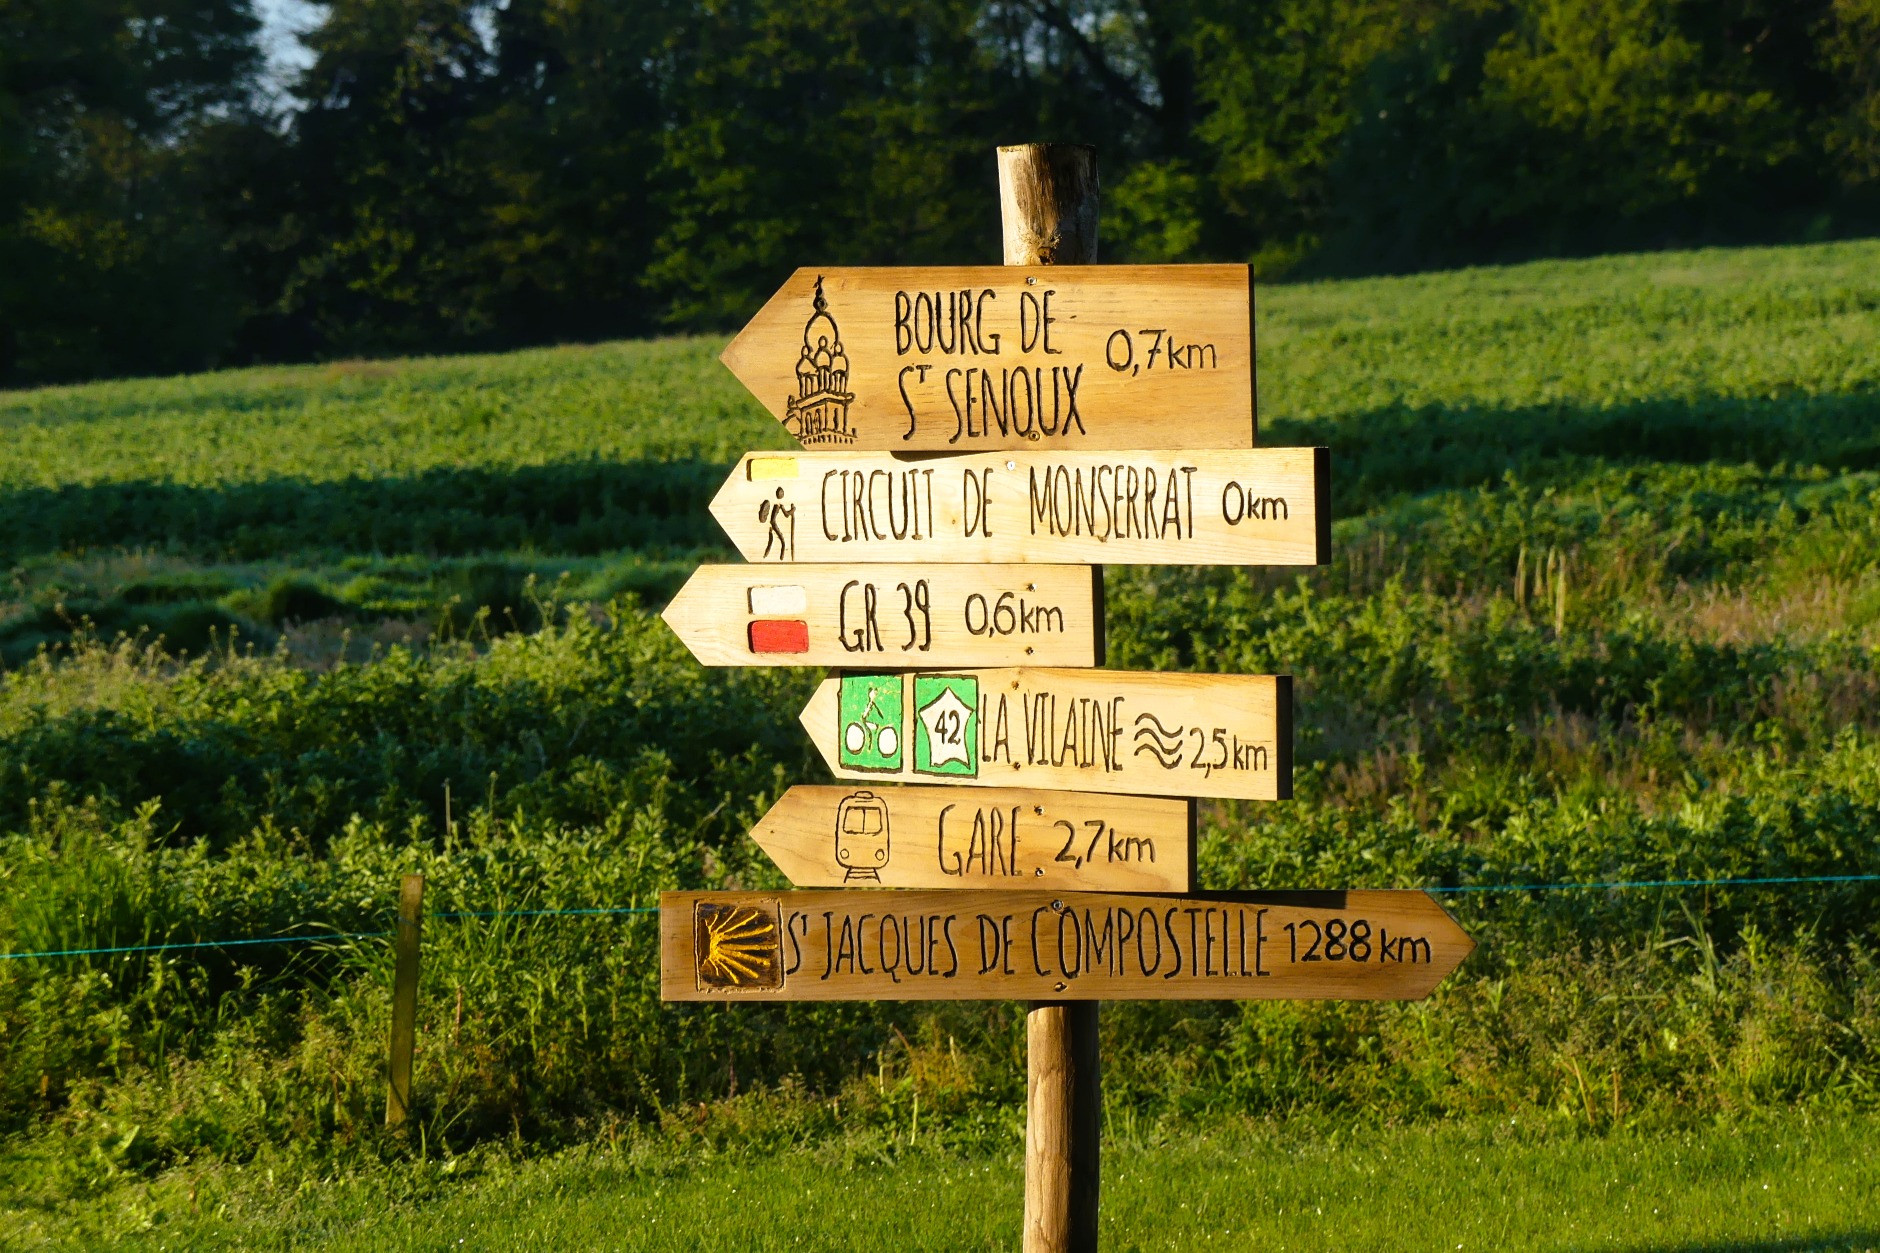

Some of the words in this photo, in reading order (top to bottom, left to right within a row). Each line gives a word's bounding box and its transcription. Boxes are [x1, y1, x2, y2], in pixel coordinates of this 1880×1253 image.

[894, 289, 1001, 356] BOURG
[1019, 289, 1063, 355] DE
[945, 363, 1087, 444] SENOUX
[821, 467, 935, 542] CIRCUIT
[962, 468, 994, 538] DE
[1029, 464, 1198, 542] MONSERRAT
[838, 579, 884, 653] GR
[897, 579, 933, 652] 39
[933, 709, 962, 746] 42
[981, 691, 1012, 765] LA
[1022, 690, 1126, 774] VILAINE
[937, 803, 1024, 878] GARE
[820, 910, 959, 984] JACQUES
[975, 912, 1016, 976] DE
[1030, 905, 1271, 980] COMPOSTELLE
